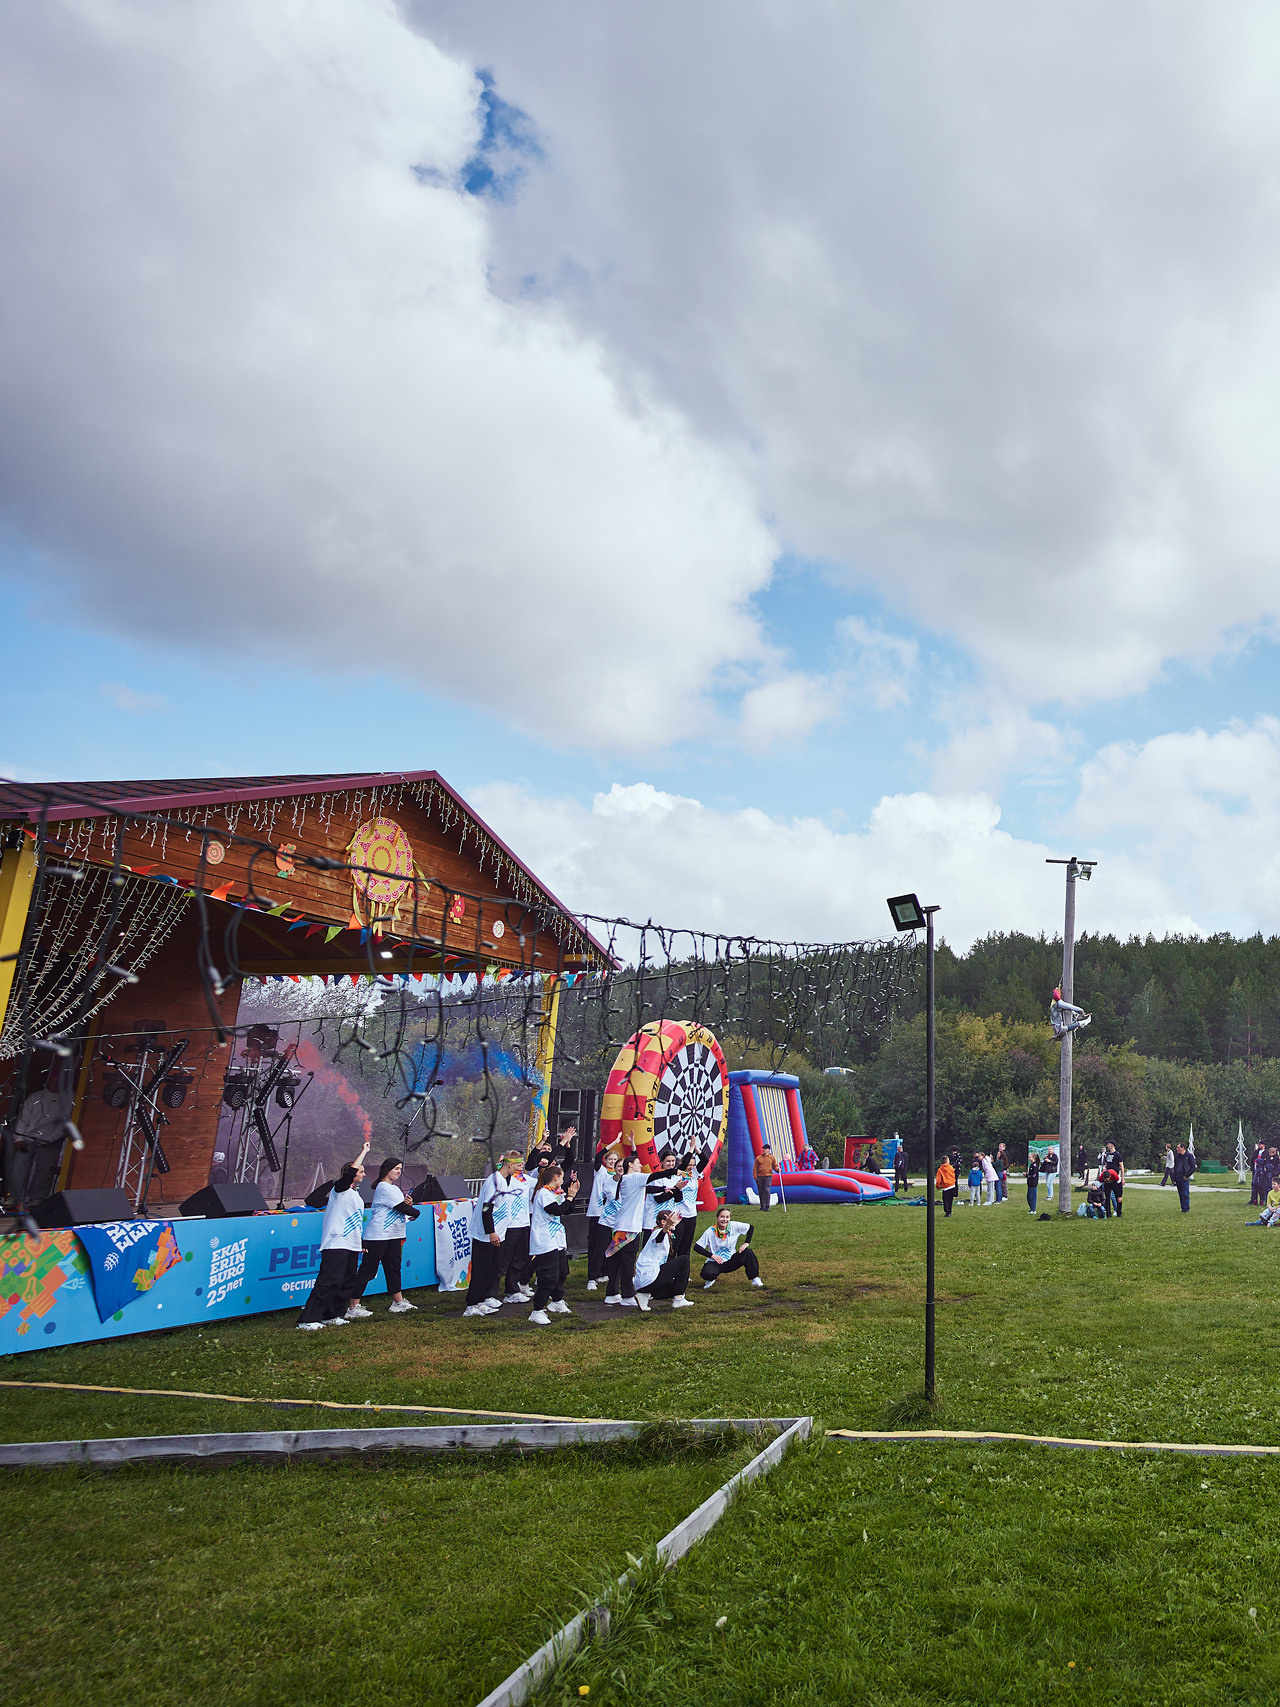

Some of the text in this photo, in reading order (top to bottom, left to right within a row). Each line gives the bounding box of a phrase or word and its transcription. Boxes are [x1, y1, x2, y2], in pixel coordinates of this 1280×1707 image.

[210, 1250, 247, 1276] ERIN
[211, 1237, 249, 1263] EKAT
[208, 1262, 245, 1288] BURG
